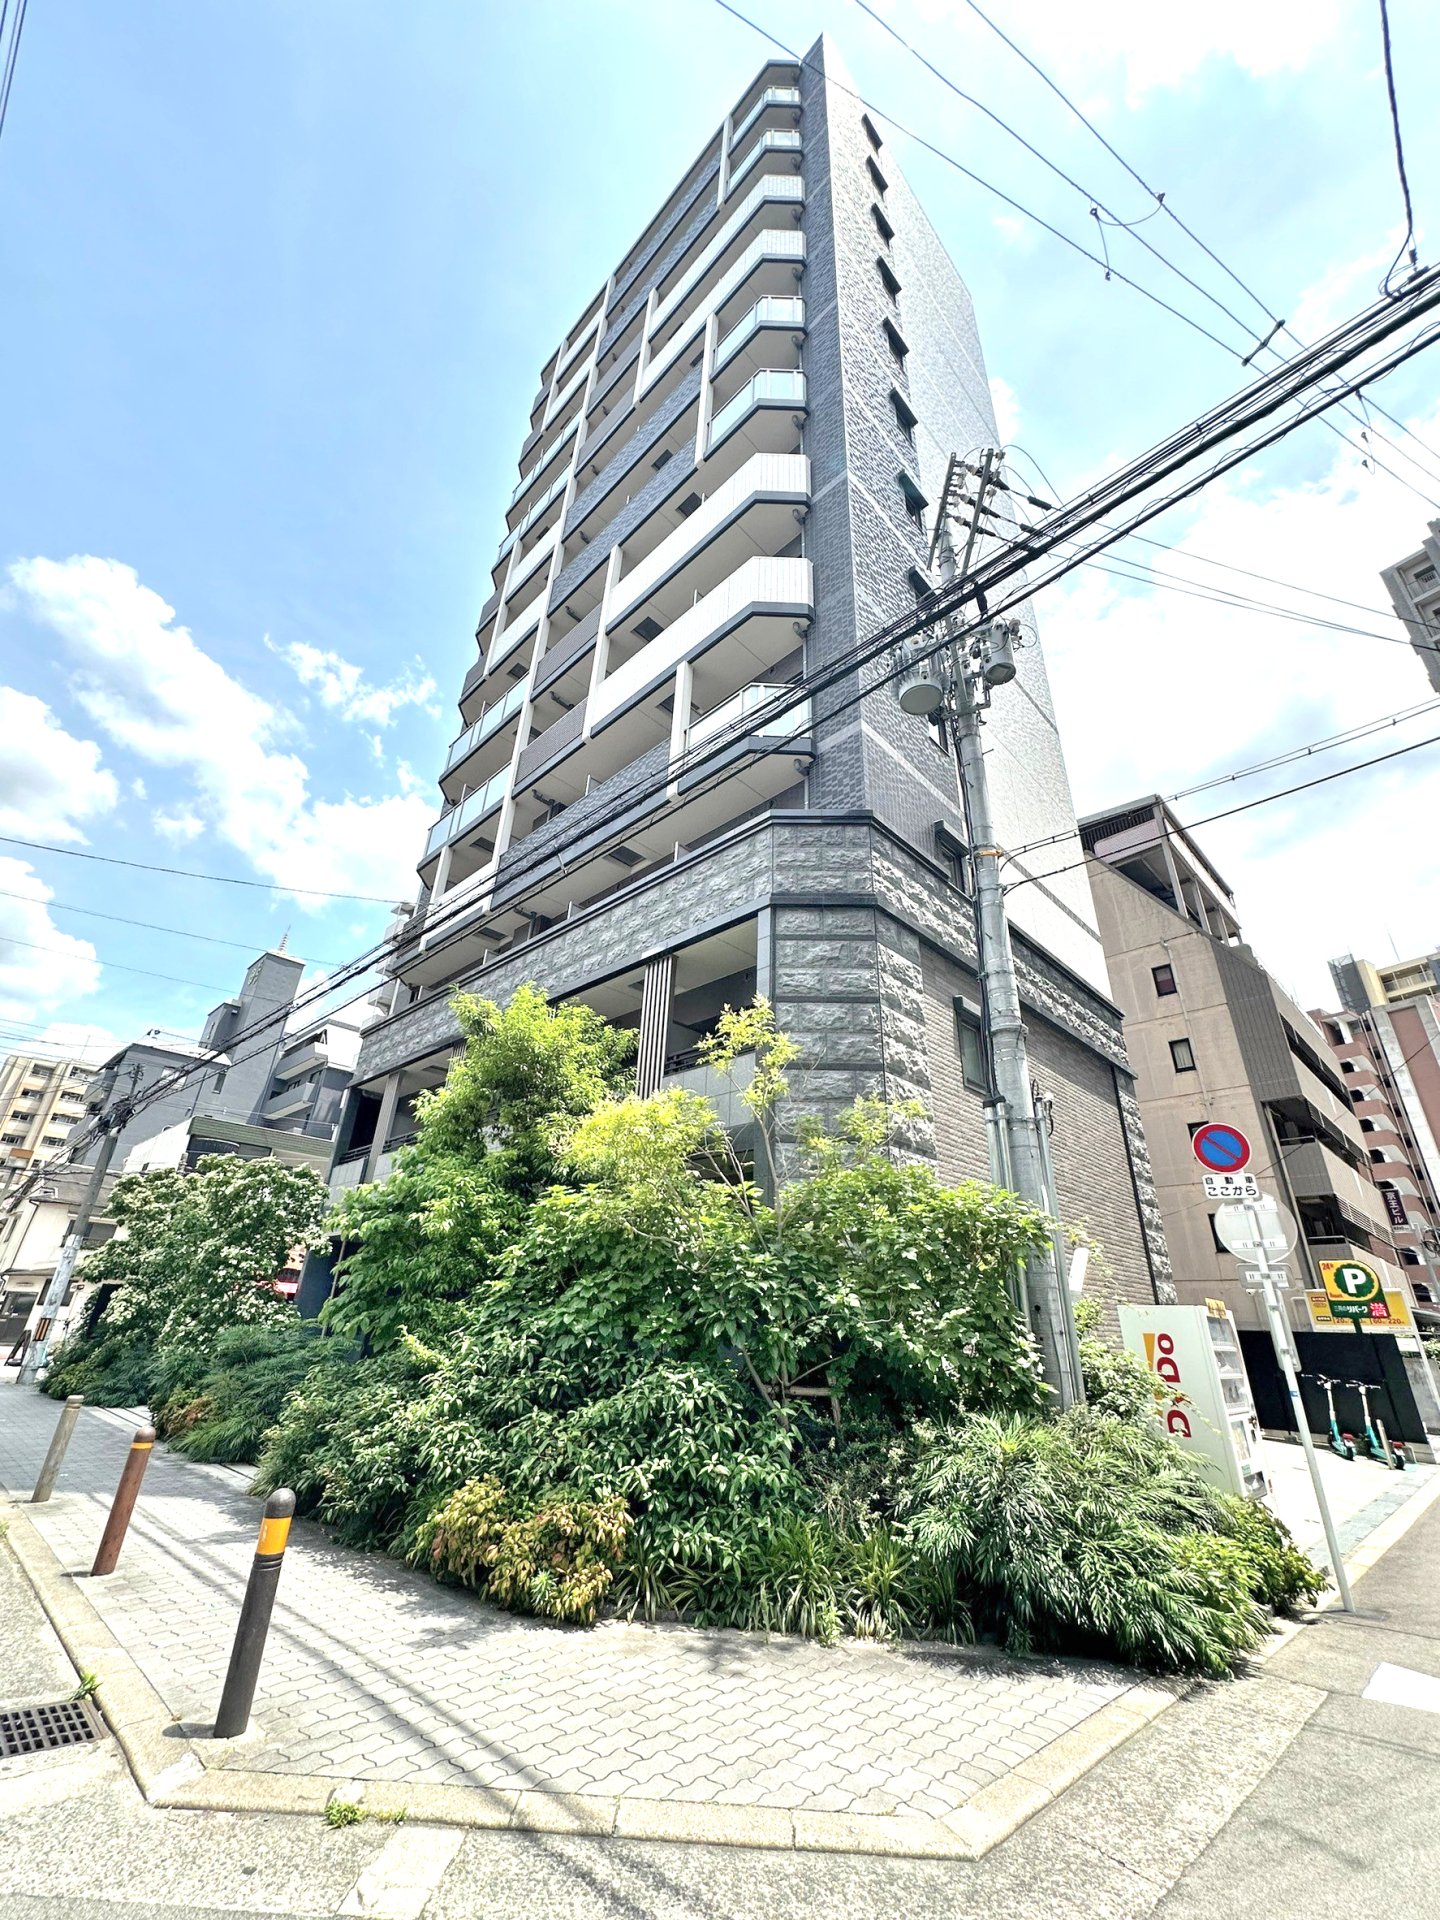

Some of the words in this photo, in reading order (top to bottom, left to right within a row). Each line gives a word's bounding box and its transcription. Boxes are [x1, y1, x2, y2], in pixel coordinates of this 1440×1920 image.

[1205, 1176, 1254, 1185] 自動車
[1207, 1186, 1257, 1197] ここから
[1385, 1191, 1404, 1224] 京王ビル
[1342, 1268, 1366, 1294] P
